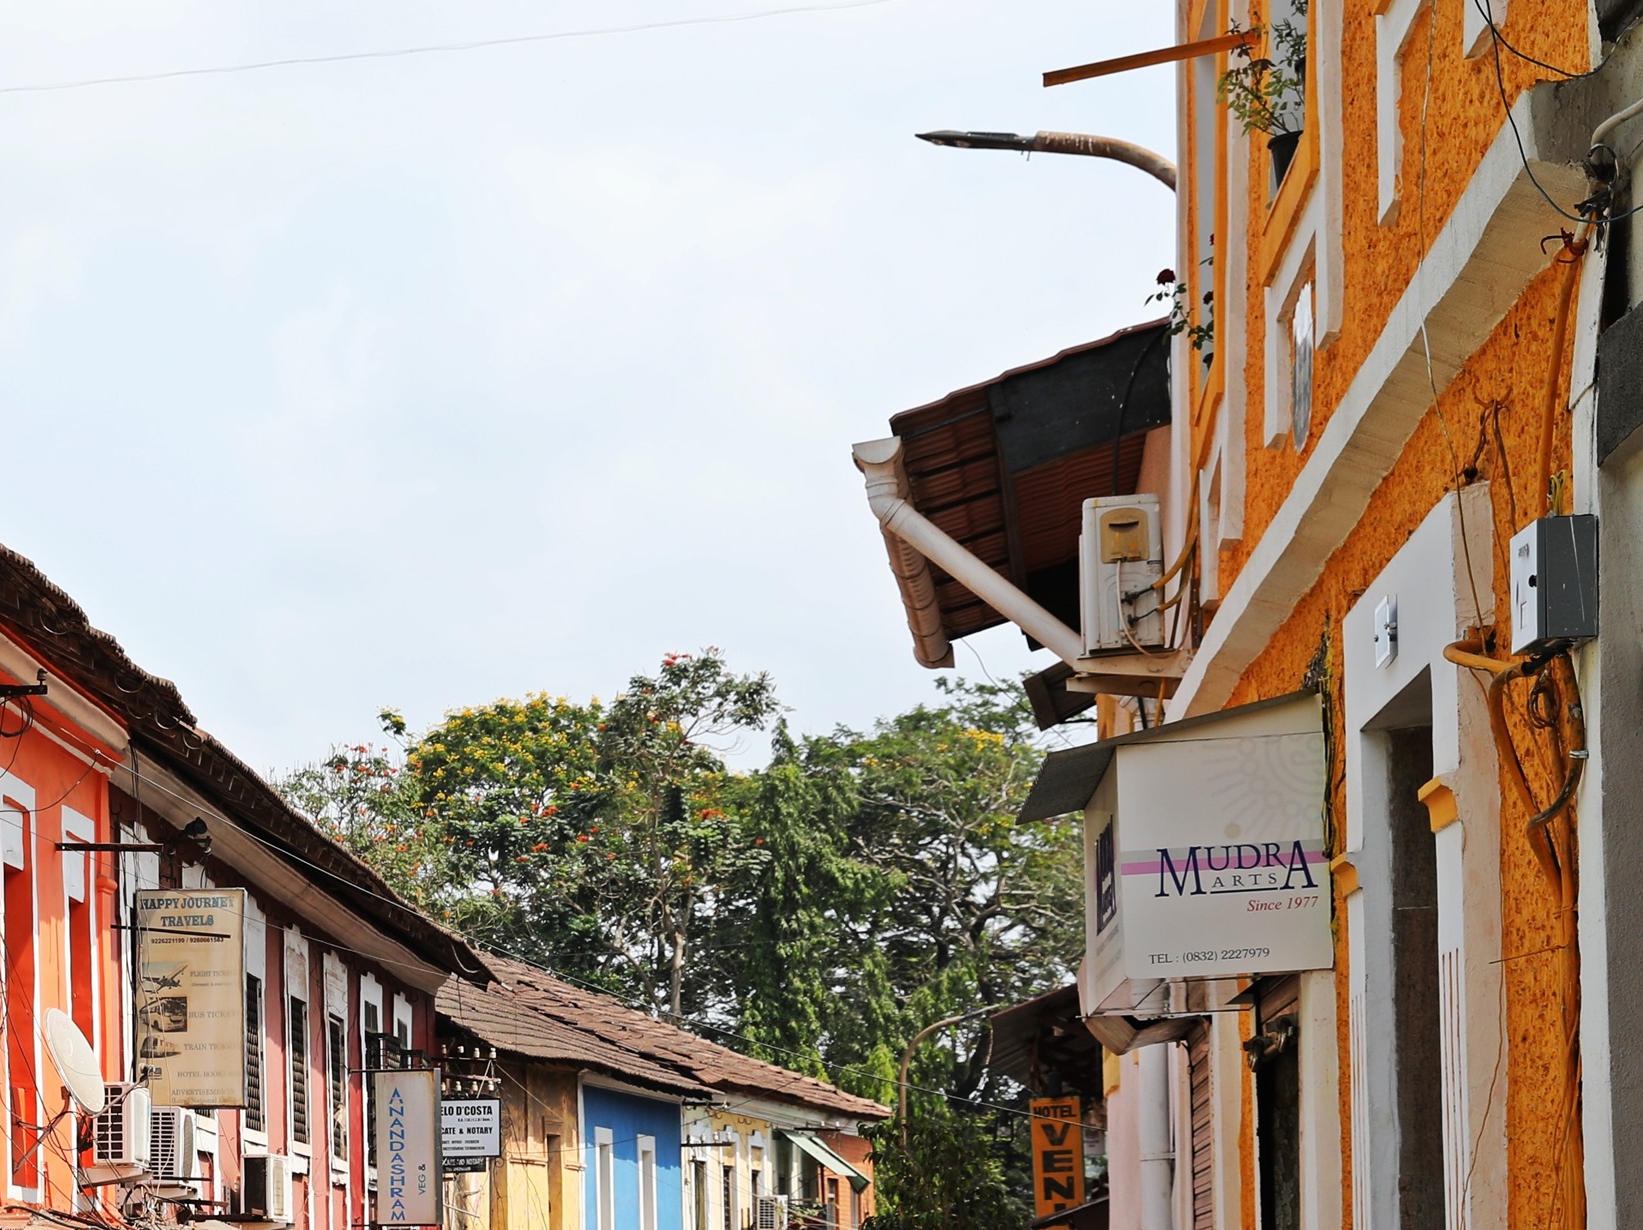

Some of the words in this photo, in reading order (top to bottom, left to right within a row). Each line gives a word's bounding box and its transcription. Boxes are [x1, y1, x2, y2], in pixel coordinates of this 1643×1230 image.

[1154, 840, 1319, 898] MUDRA
[1211, 873, 1278, 888] ARTS
[140, 897, 180, 909] HAPPY
[181, 895, 235, 909] JOURNEY
[1247, 897, 1283, 912] Since
[1287, 895, 1319, 910] 1977
[160, 915, 214, 927] TRAVELS
[1182, 950, 1218, 963] (0832)
[1221, 947, 1270, 961] 2227979
[189, 1010, 205, 1018] BUS
[456, 1105, 493, 1116] D'COSTA
[1033, 1104, 1077, 1119] HOTEL
[467, 1127, 493, 1135] NOTARY
[389, 1088, 406, 1221] ANANDASHRAM
[418, 1174, 426, 1195] VEG
